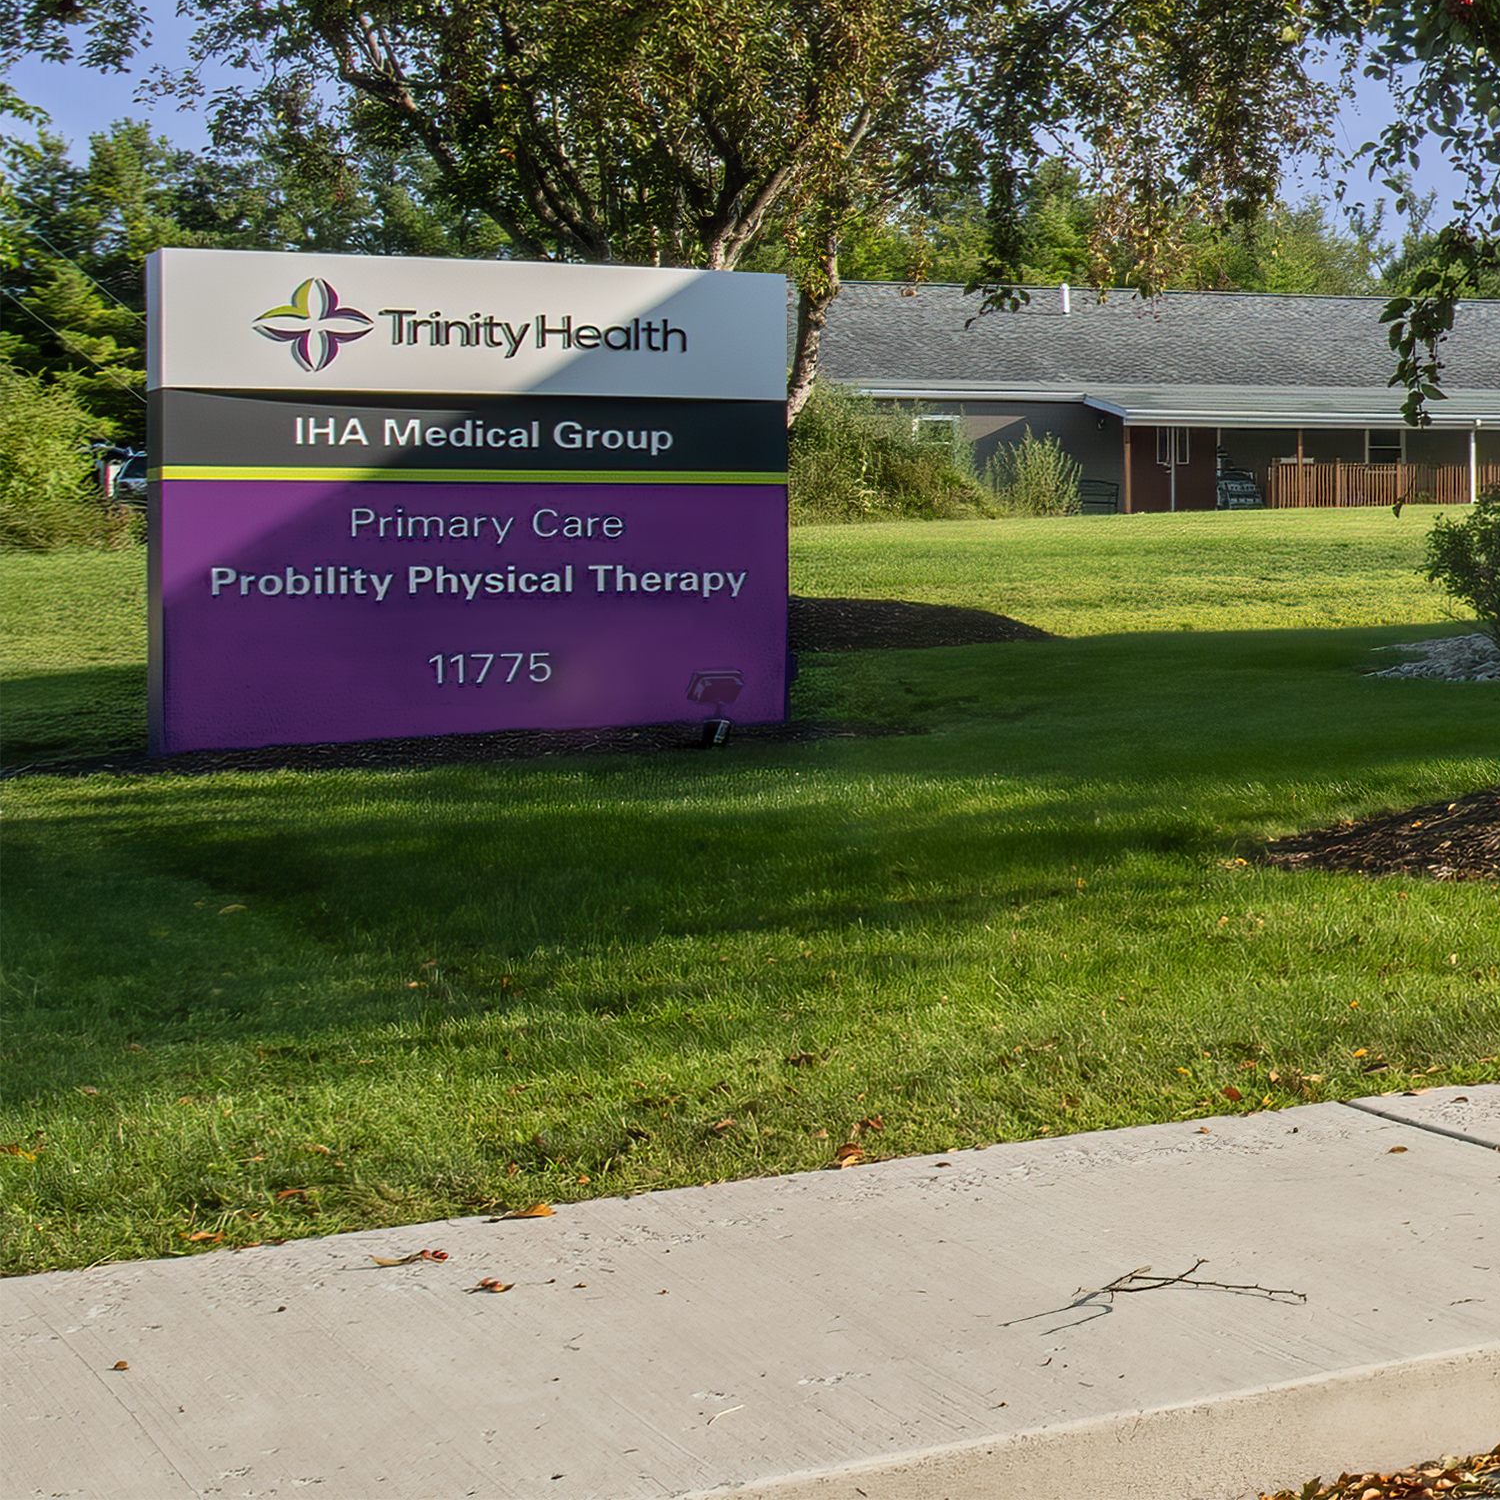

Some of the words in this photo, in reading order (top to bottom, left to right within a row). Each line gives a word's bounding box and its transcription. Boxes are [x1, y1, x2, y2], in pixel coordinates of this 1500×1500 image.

[378, 307, 530, 358] Trinity
[536, 313, 689, 353] Health
[294, 415, 369, 446] IHA
[383, 418, 540, 449] Medical
[553, 420, 674, 456] Group
[350, 507, 513, 544] Primary
[532, 508, 624, 539] Care
[210, 566, 393, 602] Probility
[407, 566, 573, 601] Physical
[588, 563, 747, 598] Therapy
[427, 652, 552, 685] 11775
